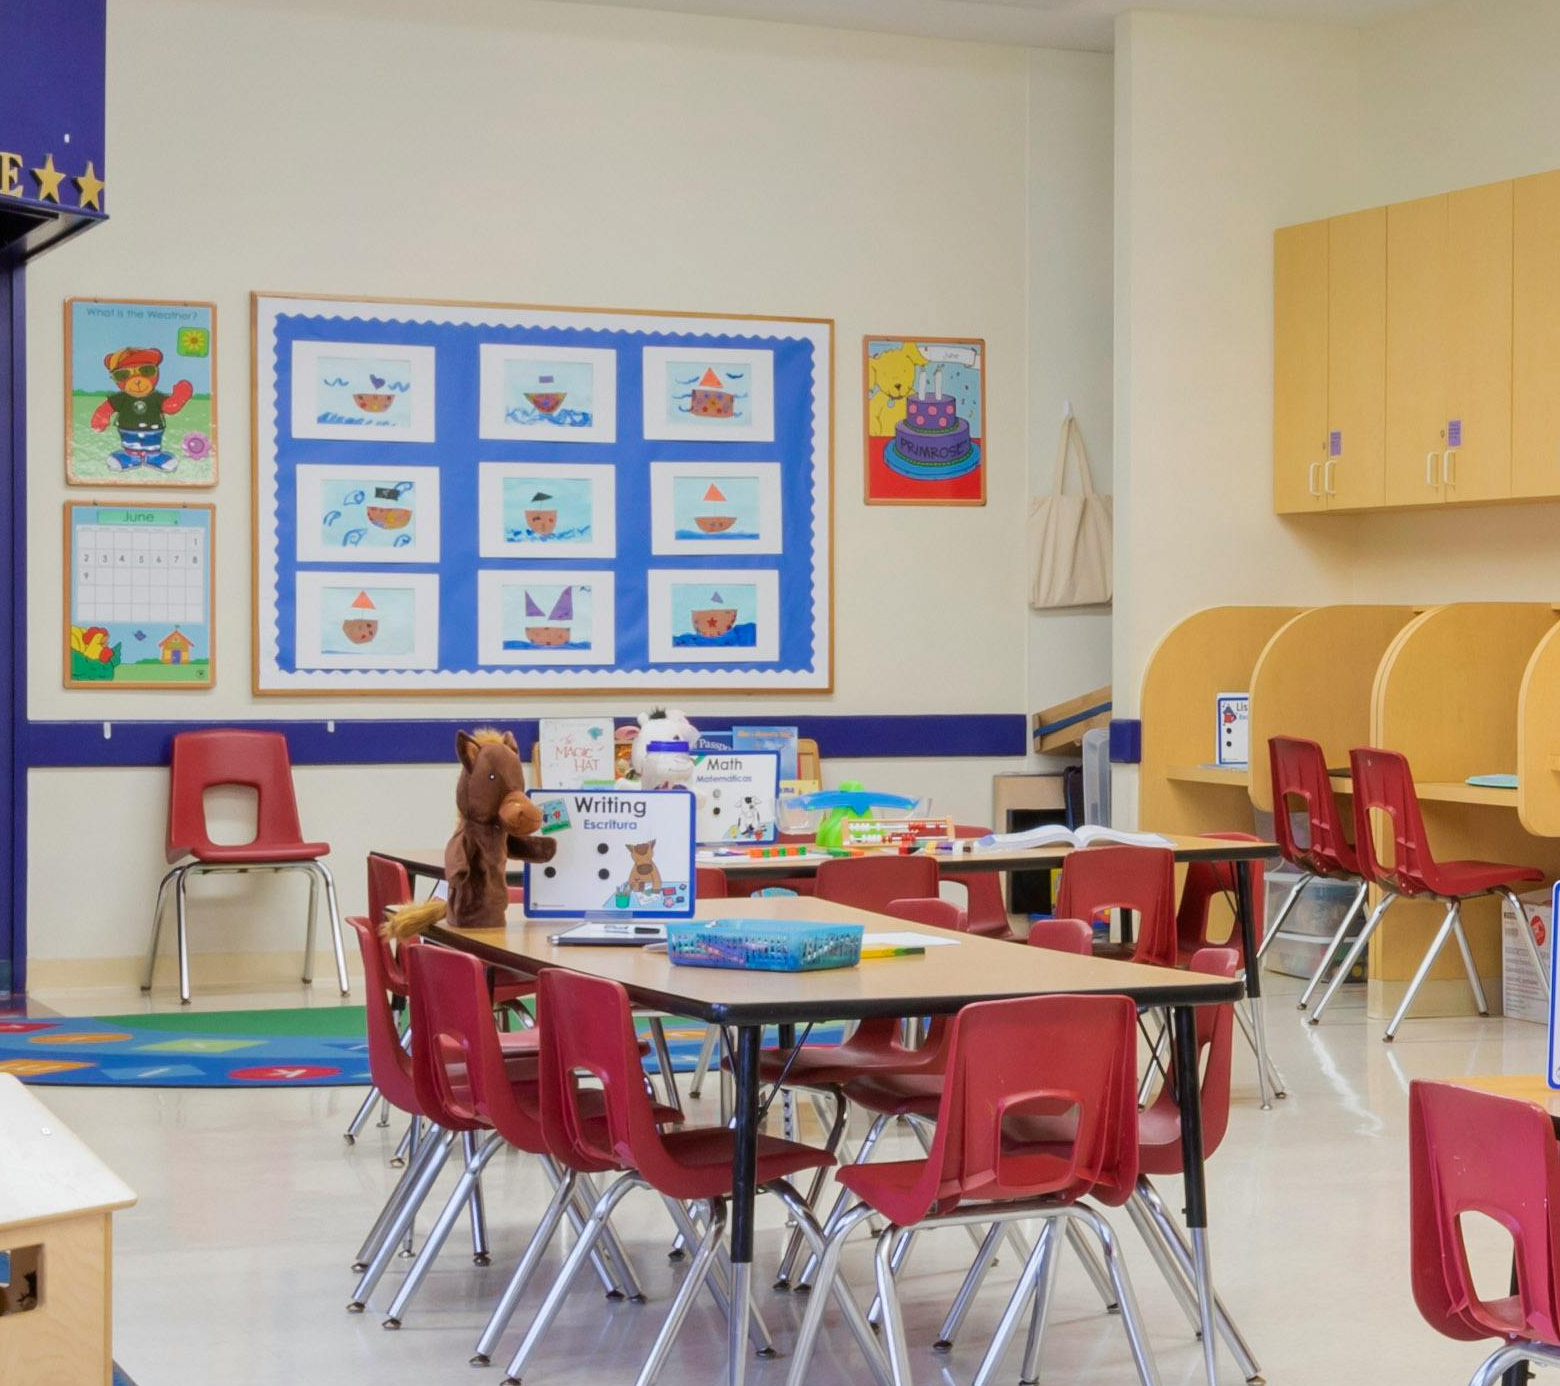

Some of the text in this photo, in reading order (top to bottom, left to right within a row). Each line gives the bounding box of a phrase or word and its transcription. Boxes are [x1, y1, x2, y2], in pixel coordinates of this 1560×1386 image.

[86, 308, 115, 319] What
[126, 309, 144, 319] the
[147, 310, 198, 321] Weather?
[123, 511, 155, 523] June
[574, 759, 601, 772] HAT
[706, 758, 743, 772] Math
[574, 796, 647, 817] Writing
[583, 819, 638, 831] Escritura
